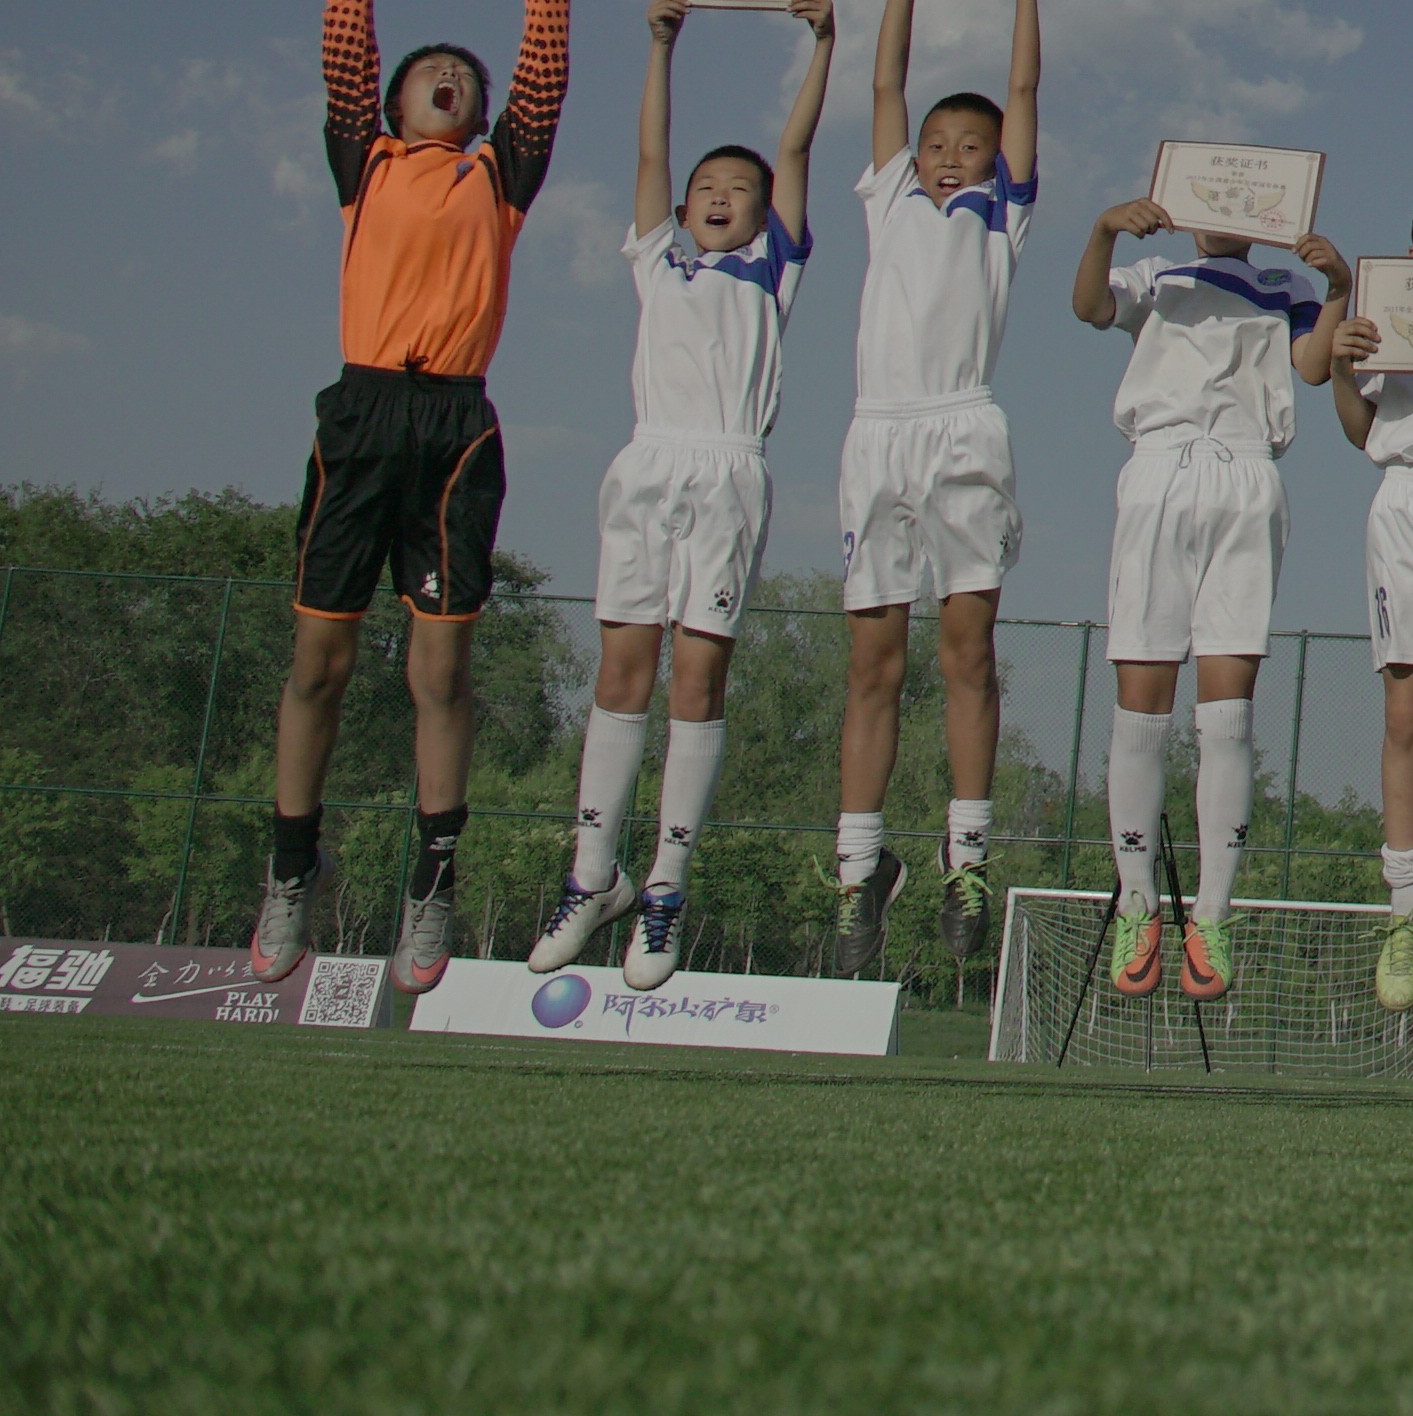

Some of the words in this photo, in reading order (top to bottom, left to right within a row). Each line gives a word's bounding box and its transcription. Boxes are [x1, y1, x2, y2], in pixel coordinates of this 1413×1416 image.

[1210, 155, 1268, 171] 获奖证书
[0, 945, 115, 992] 福驰
[226, 992, 279, 1007] PLAY
[215, 1006, 279, 1023] HARD!
[603, 993, 767, 1038] 阿尔山矿泉
